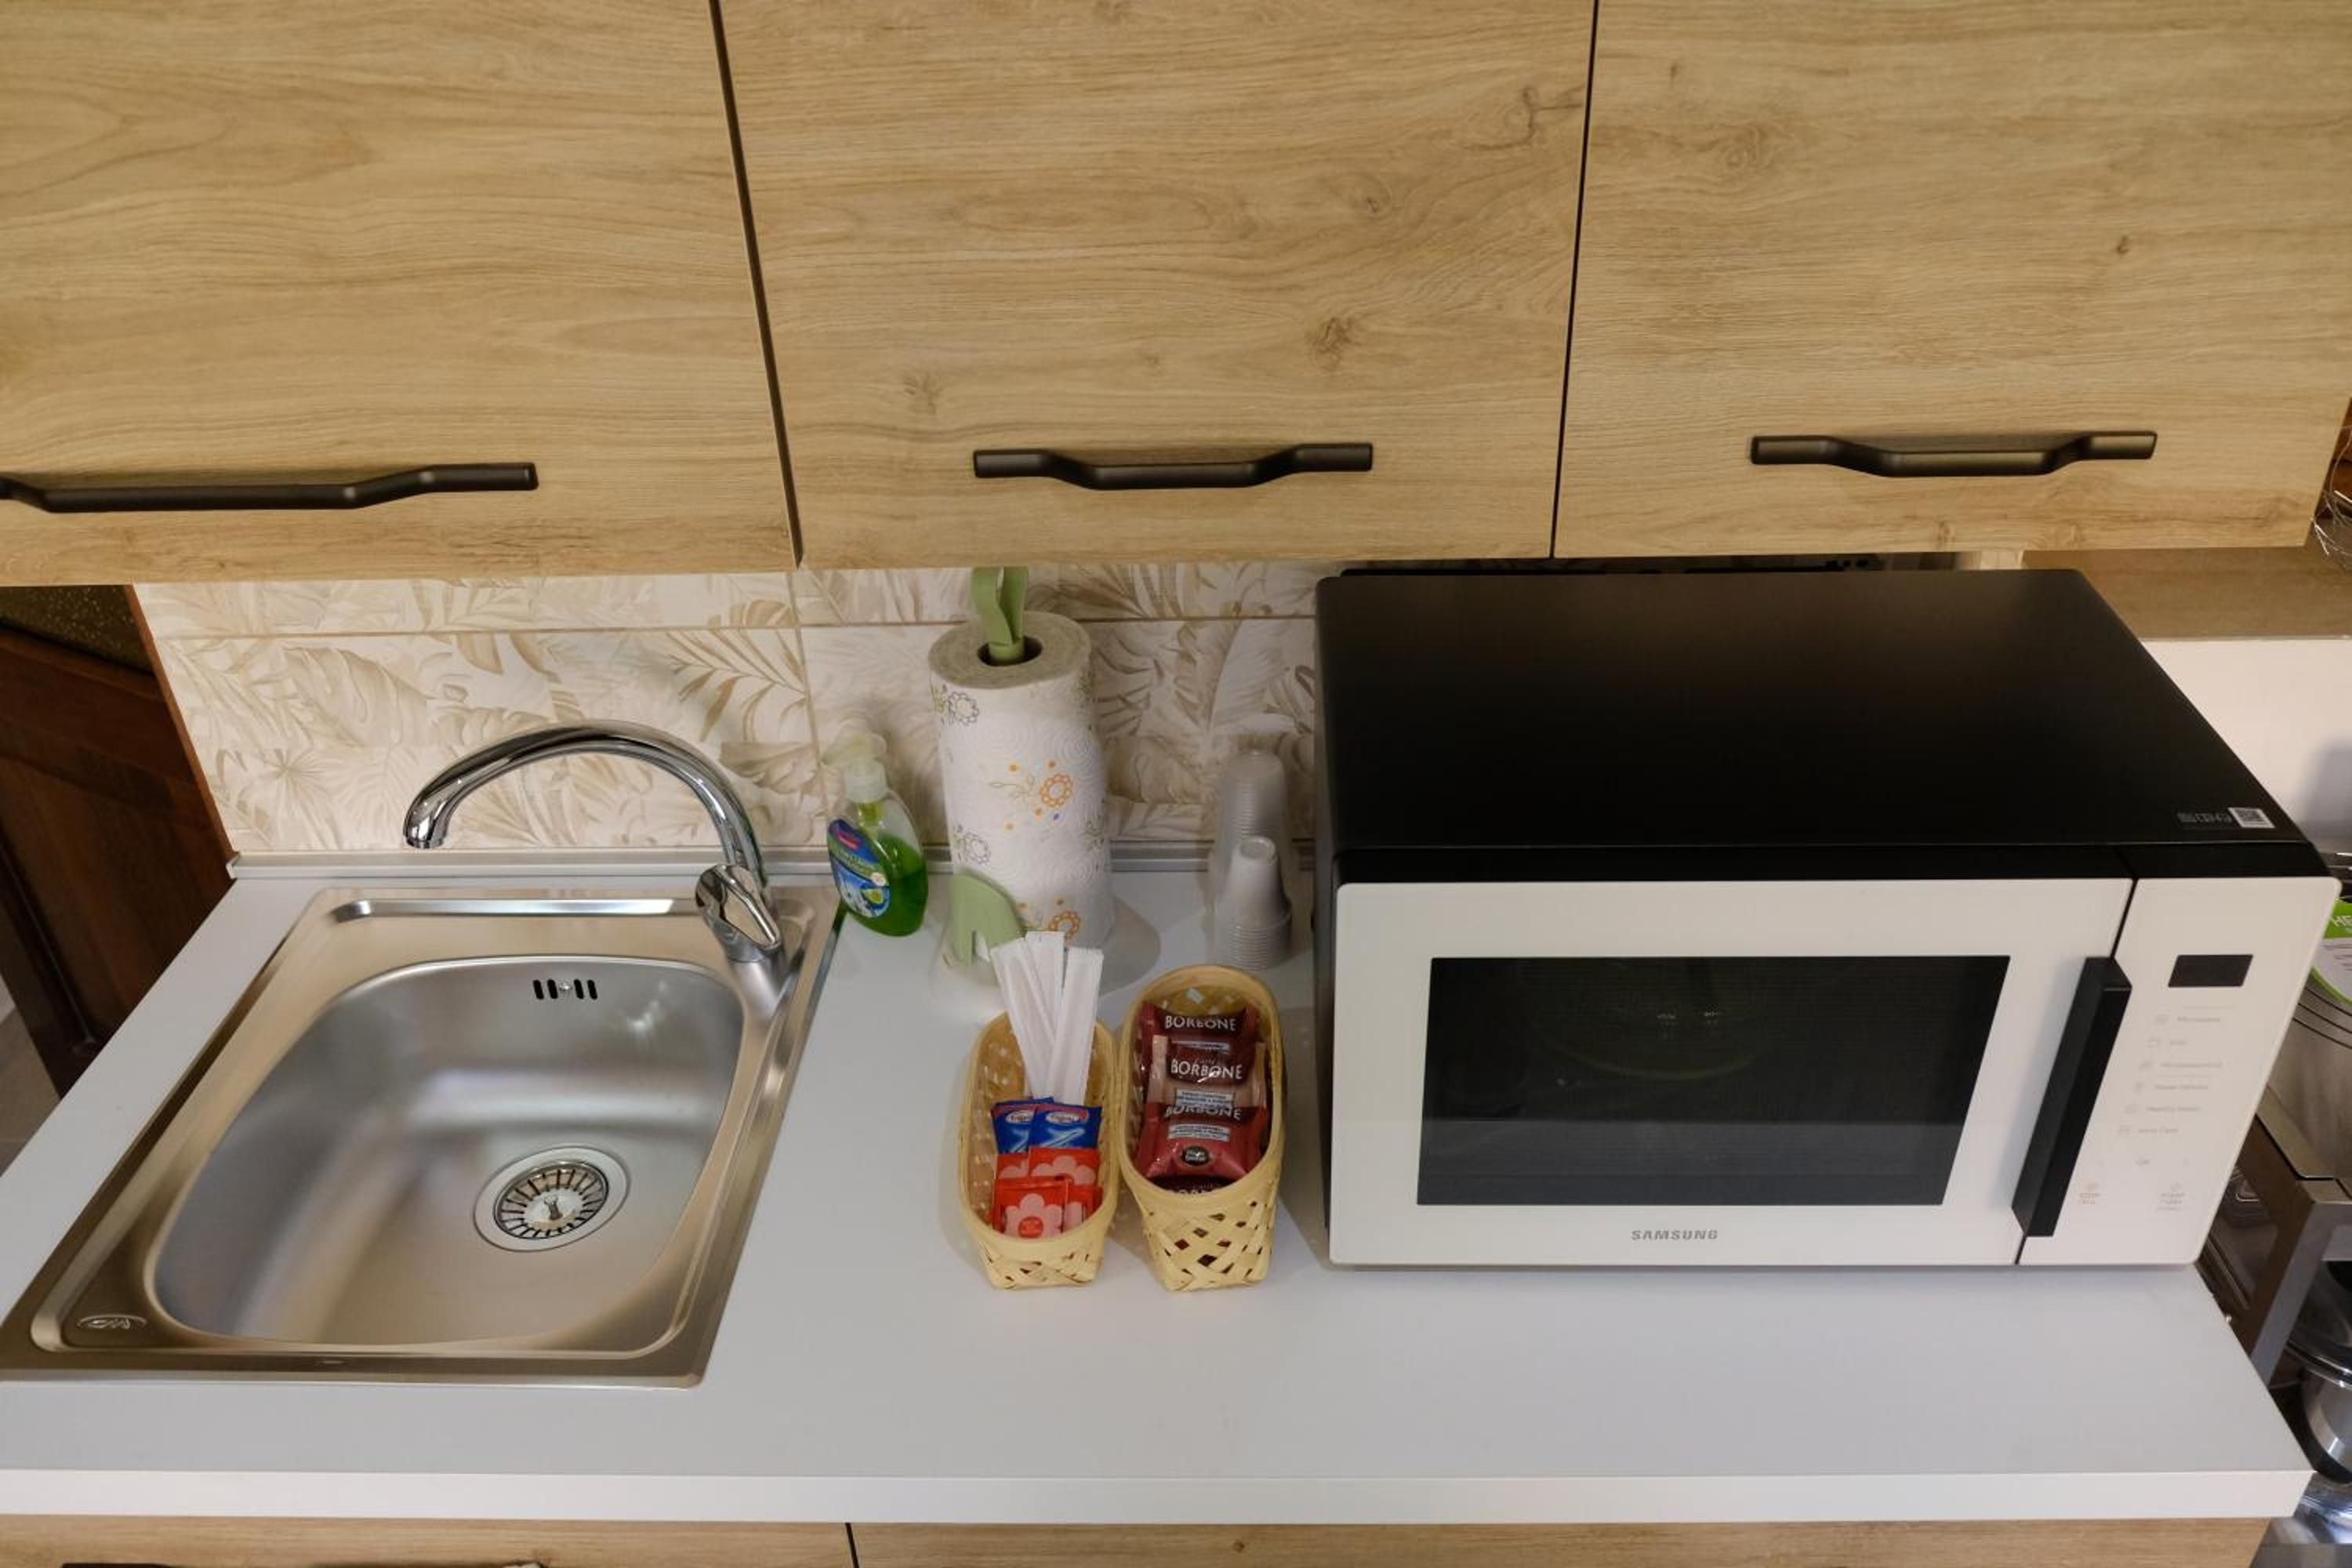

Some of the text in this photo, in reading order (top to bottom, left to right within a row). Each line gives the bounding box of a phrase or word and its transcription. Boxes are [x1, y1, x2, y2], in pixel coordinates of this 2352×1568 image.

[1165, 1015, 1236, 1032] BORBONE
[1171, 1059, 1243, 1080] BORBONE
[1631, 1229, 1719, 1241] SAMSUNG
